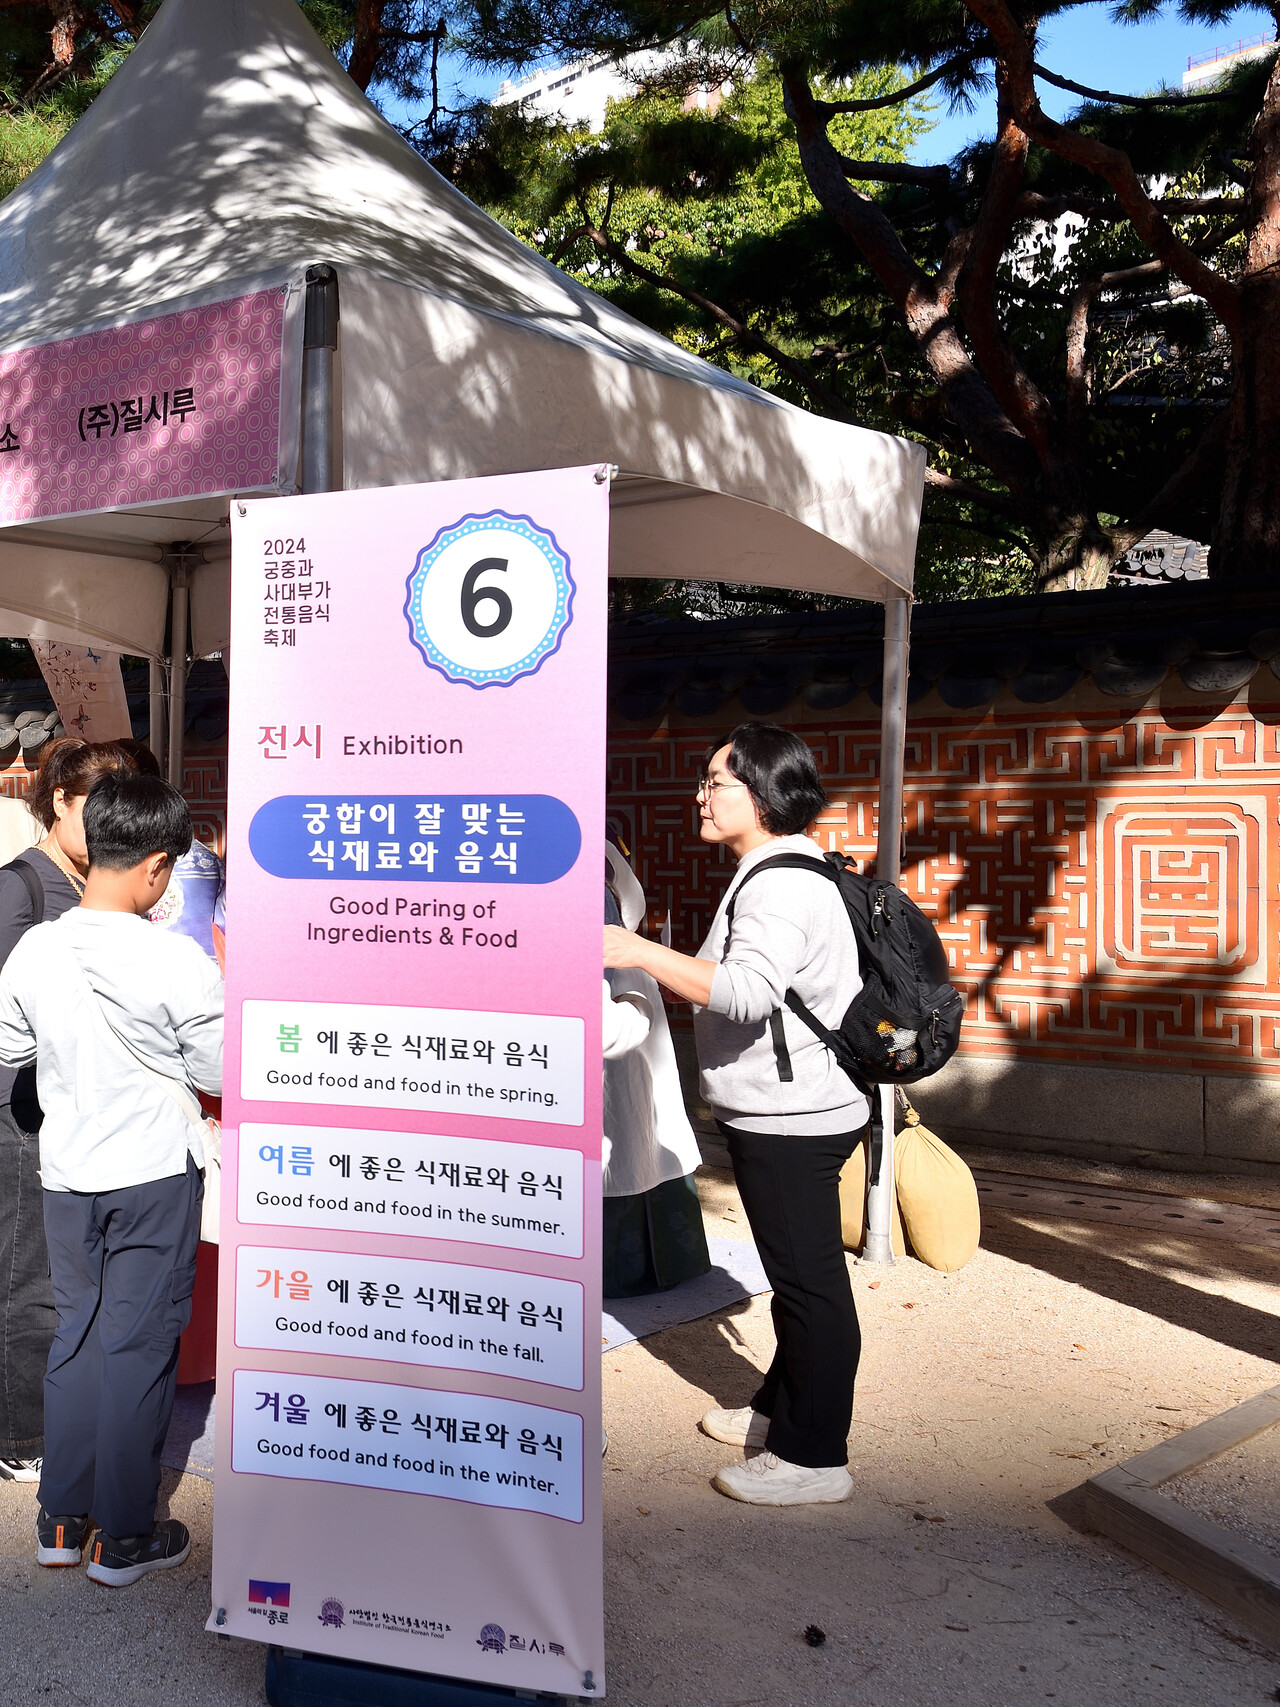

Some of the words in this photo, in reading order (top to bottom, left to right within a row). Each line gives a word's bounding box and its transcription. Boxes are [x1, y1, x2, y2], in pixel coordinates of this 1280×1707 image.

[77, 387, 197, 441] (주)질시루
[263, 538, 306, 556] 2024
[263, 558, 314, 579] 궁중과
[263, 580, 331, 601] 사대부가
[460, 557, 513, 638] 6
[263, 603, 330, 624] 전통음식
[263, 628, 296, 647] 축제
[257, 724, 322, 760] 전시
[343, 734, 464, 756] Exhibition
[302, 803, 395, 835] 궁합이
[414, 803, 445, 835] 잘
[462, 803, 525, 837] 맞는
[308, 840, 438, 873] 식재료와
[454, 842, 517, 875] 음식
[329, 896, 389, 916] Good
[395, 898, 465, 920] Paring
[472, 900, 497, 918] of
[307, 922, 432, 945] Ingredients
[439, 927, 454, 946] &
[462, 928, 518, 948] Food
[276, 1023, 303, 1054] 봄
[317, 1031, 338, 1054] 에
[347, 1031, 392, 1058] 좋은
[401, 1034, 495, 1064] 식재료와
[503, 1043, 549, 1069] 음식
[267, 1070, 313, 1086] Good
[318, 1072, 358, 1089] food
[364, 1074, 395, 1091] and
[401, 1077, 441, 1095] food
[446, 1080, 461, 1096] in
[467, 1082, 495, 1099] the
[500, 1086, 558, 1105] spring.
[258, 1145, 315, 1177] 여름
[329, 1154, 351, 1178] 에
[359, 1155, 405, 1182] 좋은
[415, 1159, 509, 1193] 식재료와
[517, 1171, 563, 1200] 음식
[256, 1192, 302, 1208] Good
[308, 1194, 348, 1211] food
[354, 1198, 386, 1215] and
[391, 1201, 433, 1219] food
[438, 1205, 452, 1220] in
[458, 1207, 487, 1225] the
[491, 1213, 565, 1236] summer.
[256, 1269, 313, 1301] 가을
[327, 1279, 349, 1304] 에
[357, 1280, 405, 1309] 좋은
[413, 1286, 510, 1322] 식재료와
[517, 1301, 563, 1333] 음식
[275, 1317, 323, 1334] Good
[327, 1321, 369, 1339] food
[373, 1325, 406, 1343] and
[411, 1330, 454, 1349] food
[458, 1335, 474, 1351] in
[479, 1339, 508, 1356] the
[513, 1344, 544, 1364] fall.
[254, 1391, 310, 1425] 겨울
[324, 1402, 346, 1429] 에
[354, 1406, 402, 1435] 좋은
[411, 1412, 509, 1450] 식재료와
[517, 1428, 563, 1461] 음식
[257, 1439, 304, 1458] Good
[308, 1444, 350, 1463] food
[355, 1449, 387, 1468] and
[392, 1454, 435, 1474] food
[439, 1460, 455, 1477] in
[460, 1464, 490, 1483] the
[495, 1471, 559, 1495] winter.
[267, 1609, 289, 1625] 종로
[349, 1609, 378, 1620] 사단법인
[353, 1619, 373, 1627] Institute
[381, 1624, 409, 1633] Traditional
[411, 1629, 429, 1637] Korean
[431, 1631, 444, 1639] Food
[510, 1634, 565, 1656] 질시루
